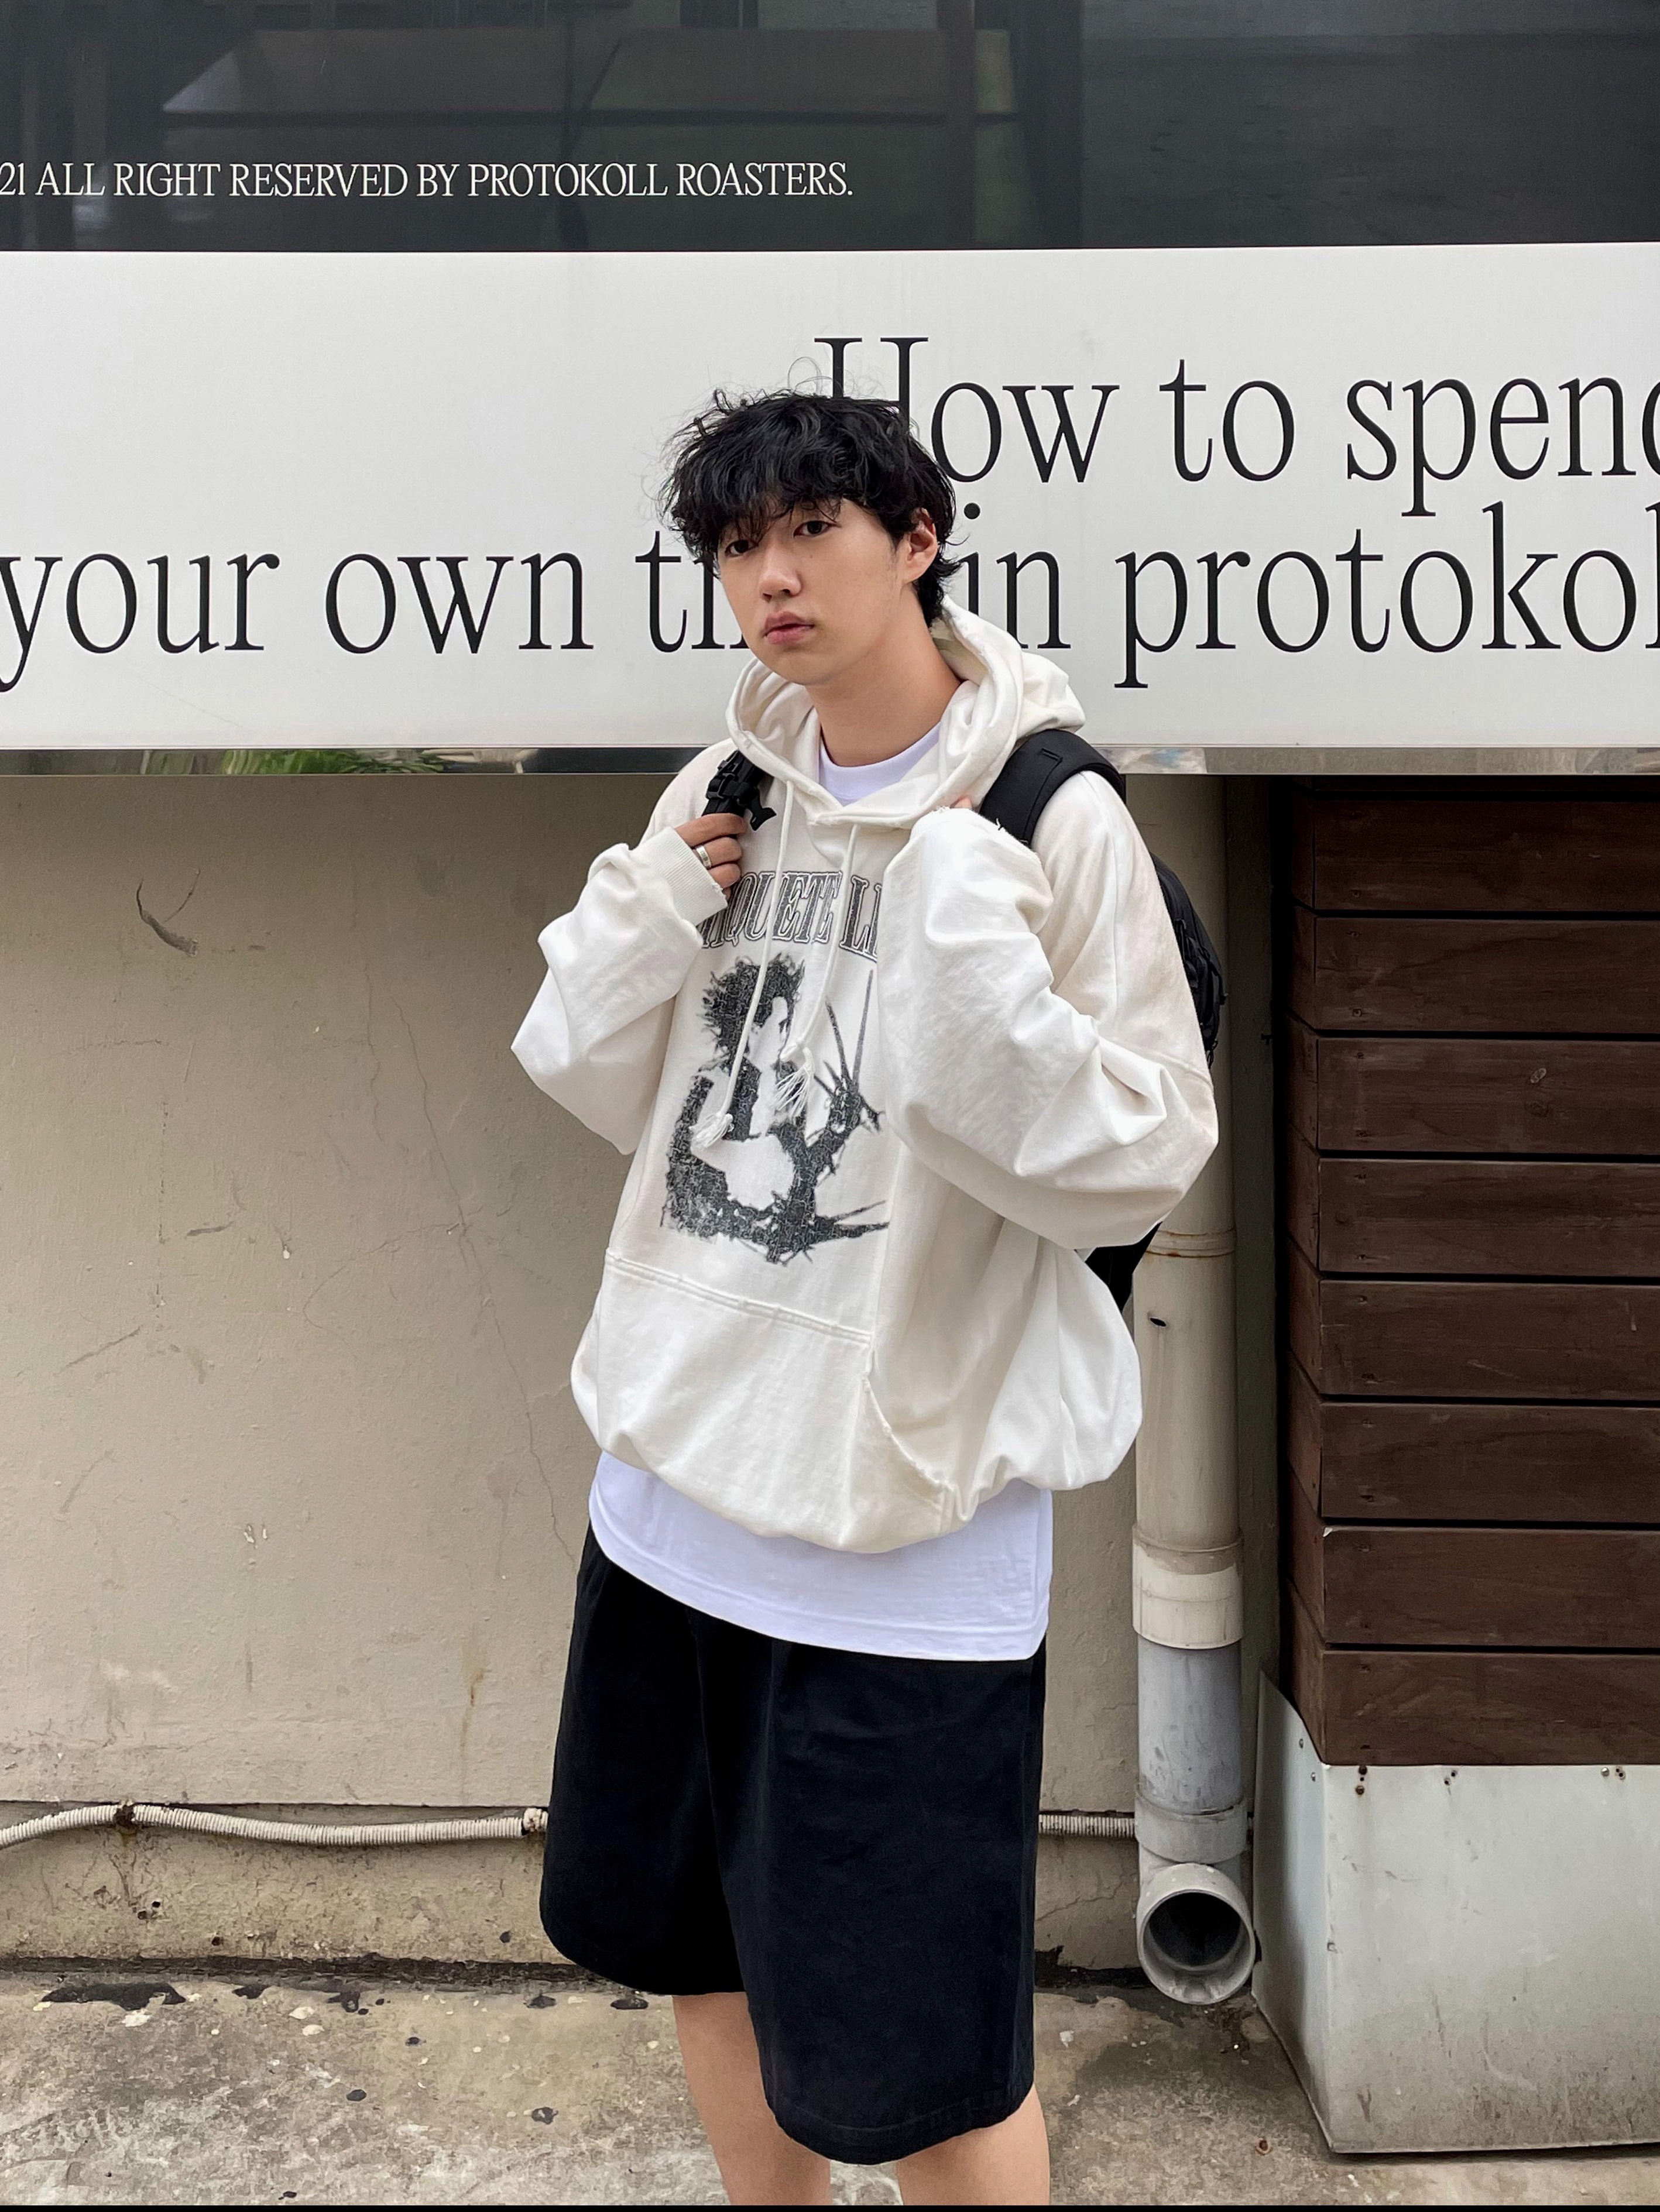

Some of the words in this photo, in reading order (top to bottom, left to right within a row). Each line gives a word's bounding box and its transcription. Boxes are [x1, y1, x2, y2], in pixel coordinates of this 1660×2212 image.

[0, 162, 26, 195] 21
[35, 162, 105, 196] ALL
[114, 162, 221, 197] RIGHT
[229, 163, 408, 197] RESERVED
[416, 163, 460, 197] BY
[468, 163, 668, 197] PROTOKOLL
[676, 162, 853, 197] ROASTERS.
[1159, 359, 1294, 482] to
[1347, 377, 1660, 517] spen
[0, 554, 280, 692] your
[325, 552, 594, 654] own
[957, 502, 1071, 649] in
